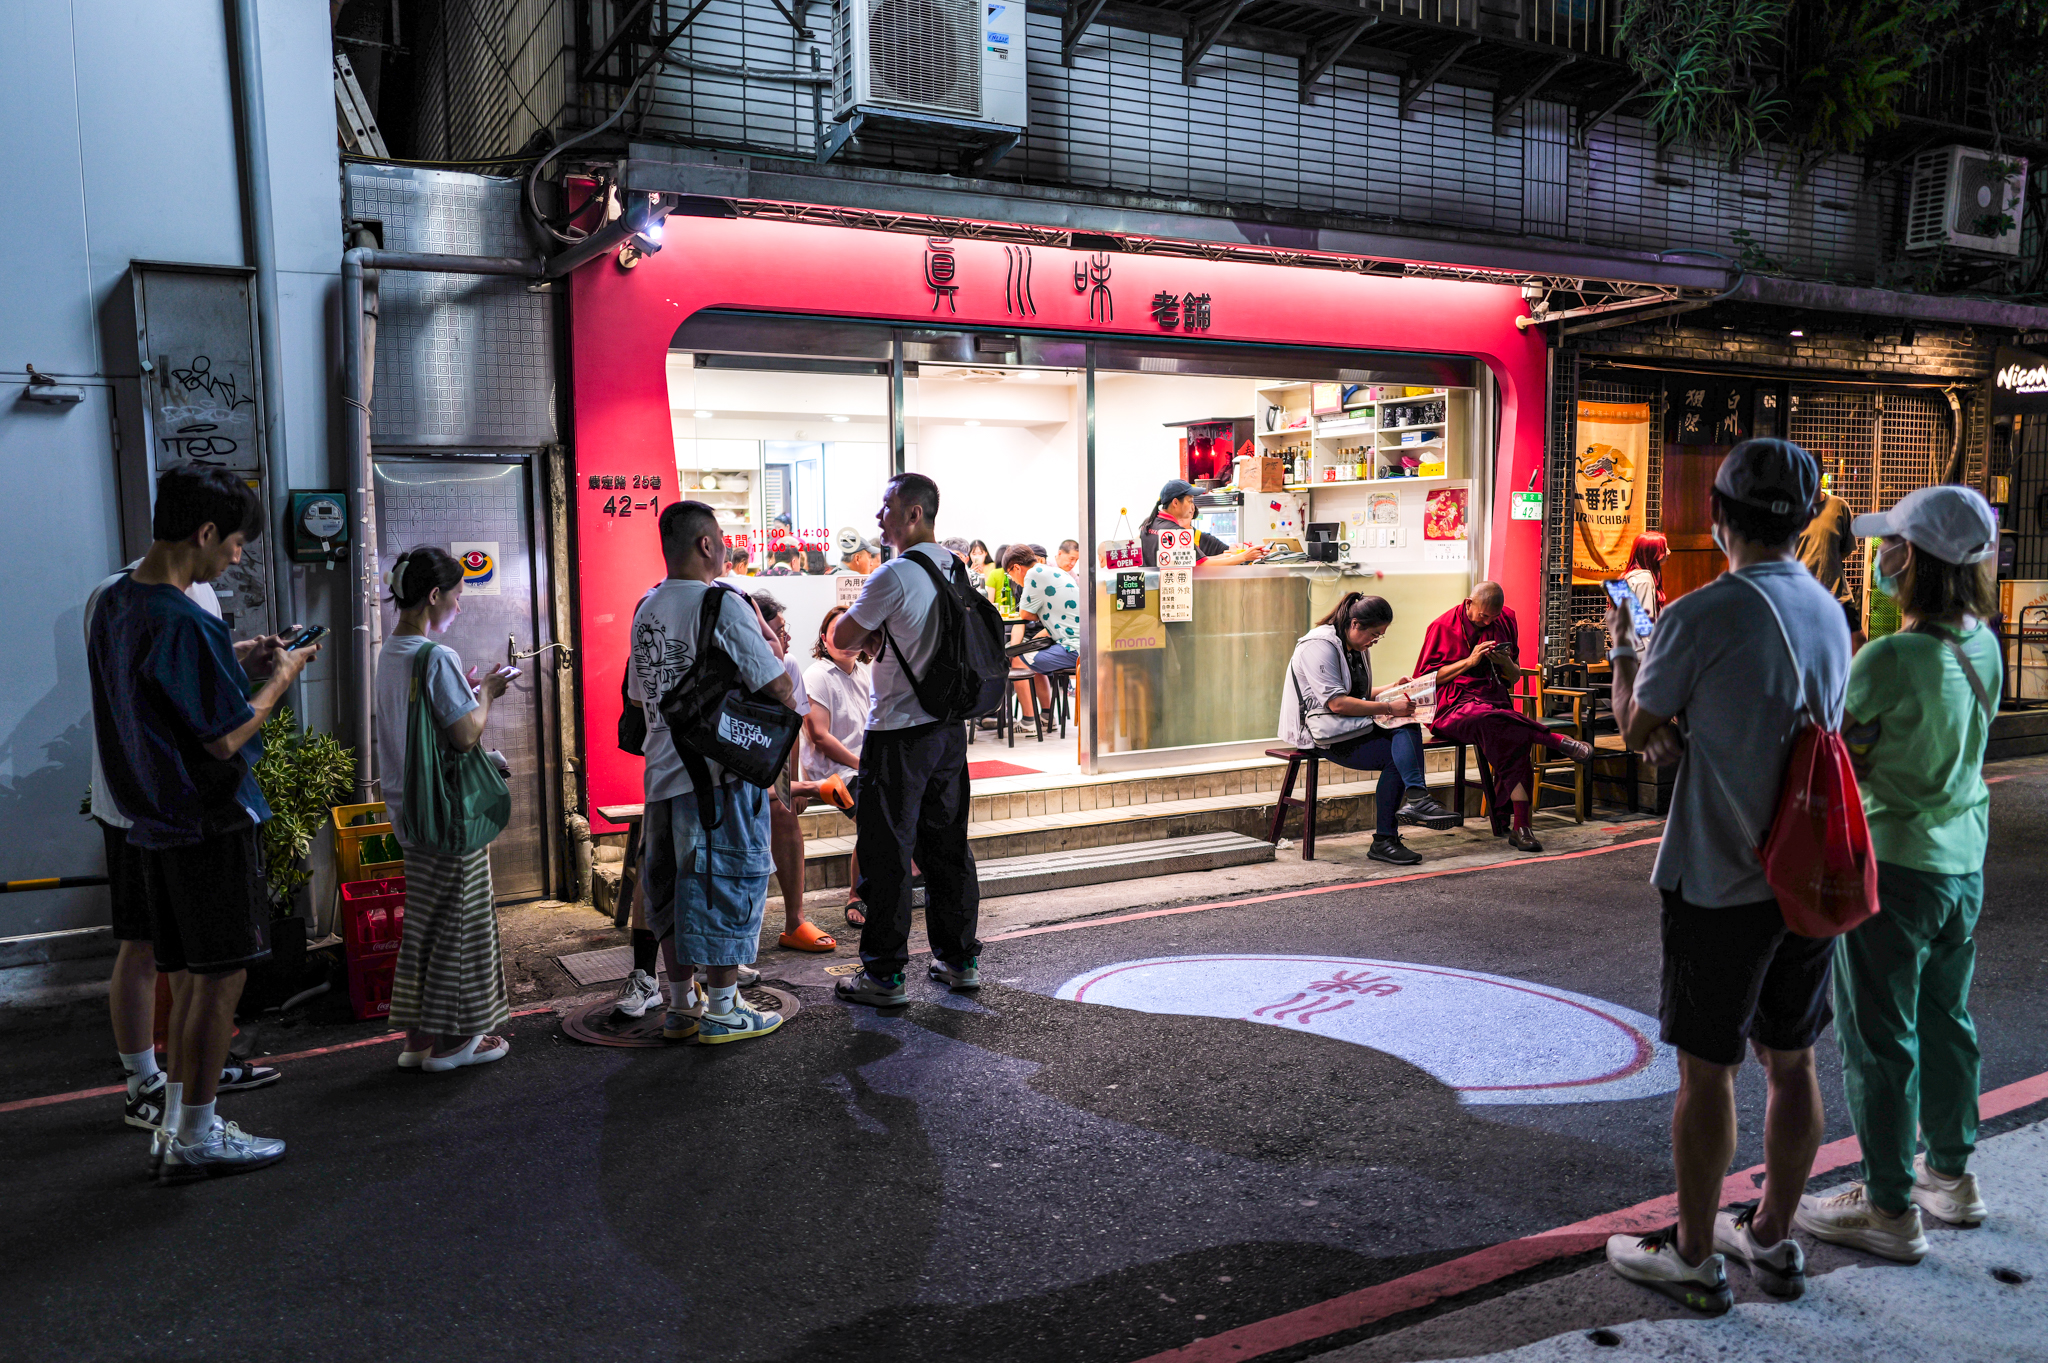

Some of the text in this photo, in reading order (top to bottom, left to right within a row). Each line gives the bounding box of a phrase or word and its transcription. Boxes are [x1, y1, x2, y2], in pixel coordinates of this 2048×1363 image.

[603, 495, 659, 517] 42-1
[1523, 506, 1534, 518] 42
[1116, 559, 1134, 568] OPEN
[1115, 637, 1156, 648] momo
[731, 717, 761, 733] FACE
[731, 725, 772, 748] NORTH
[731, 734, 752, 750] THE
